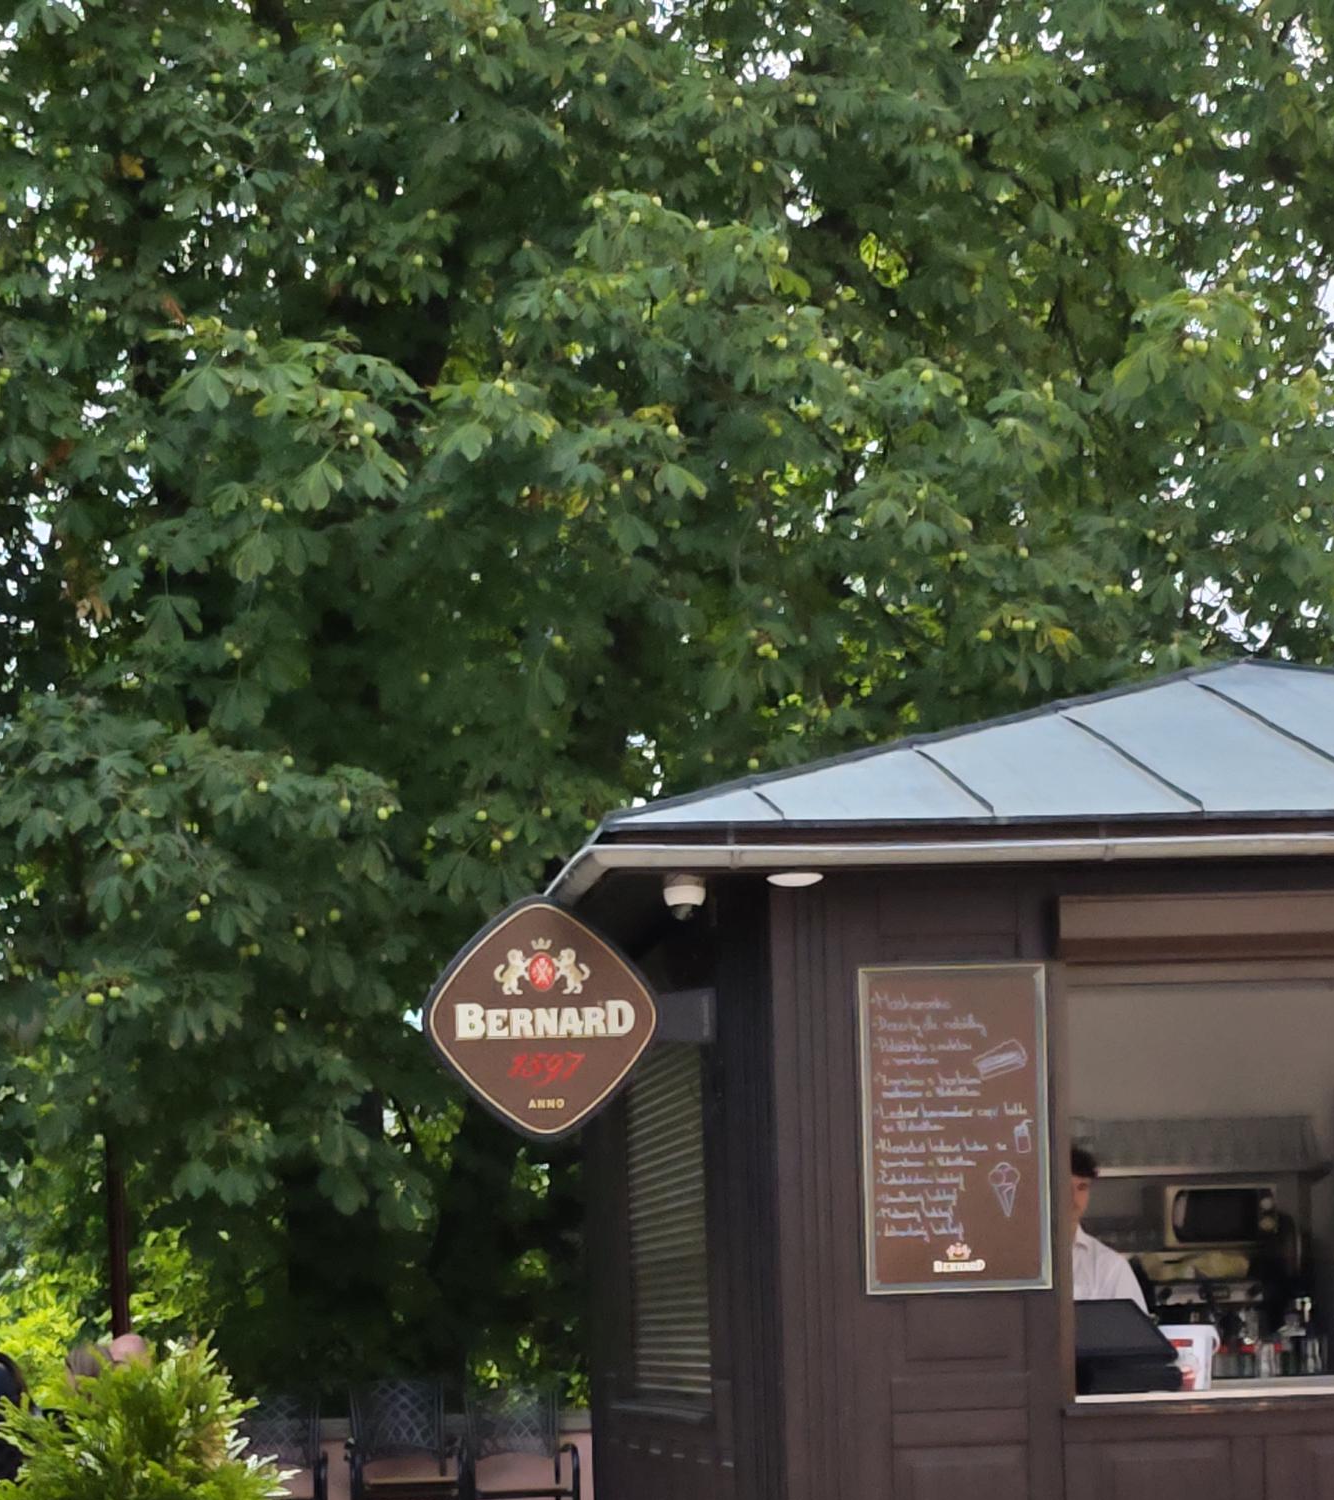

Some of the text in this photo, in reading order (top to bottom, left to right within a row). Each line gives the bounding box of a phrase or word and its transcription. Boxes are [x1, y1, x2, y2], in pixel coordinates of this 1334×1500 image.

[454, 1000, 636, 1041] BERNARD
[507, 1052, 586, 1088] 1597
[528, 1098, 565, 1110] ANNO
